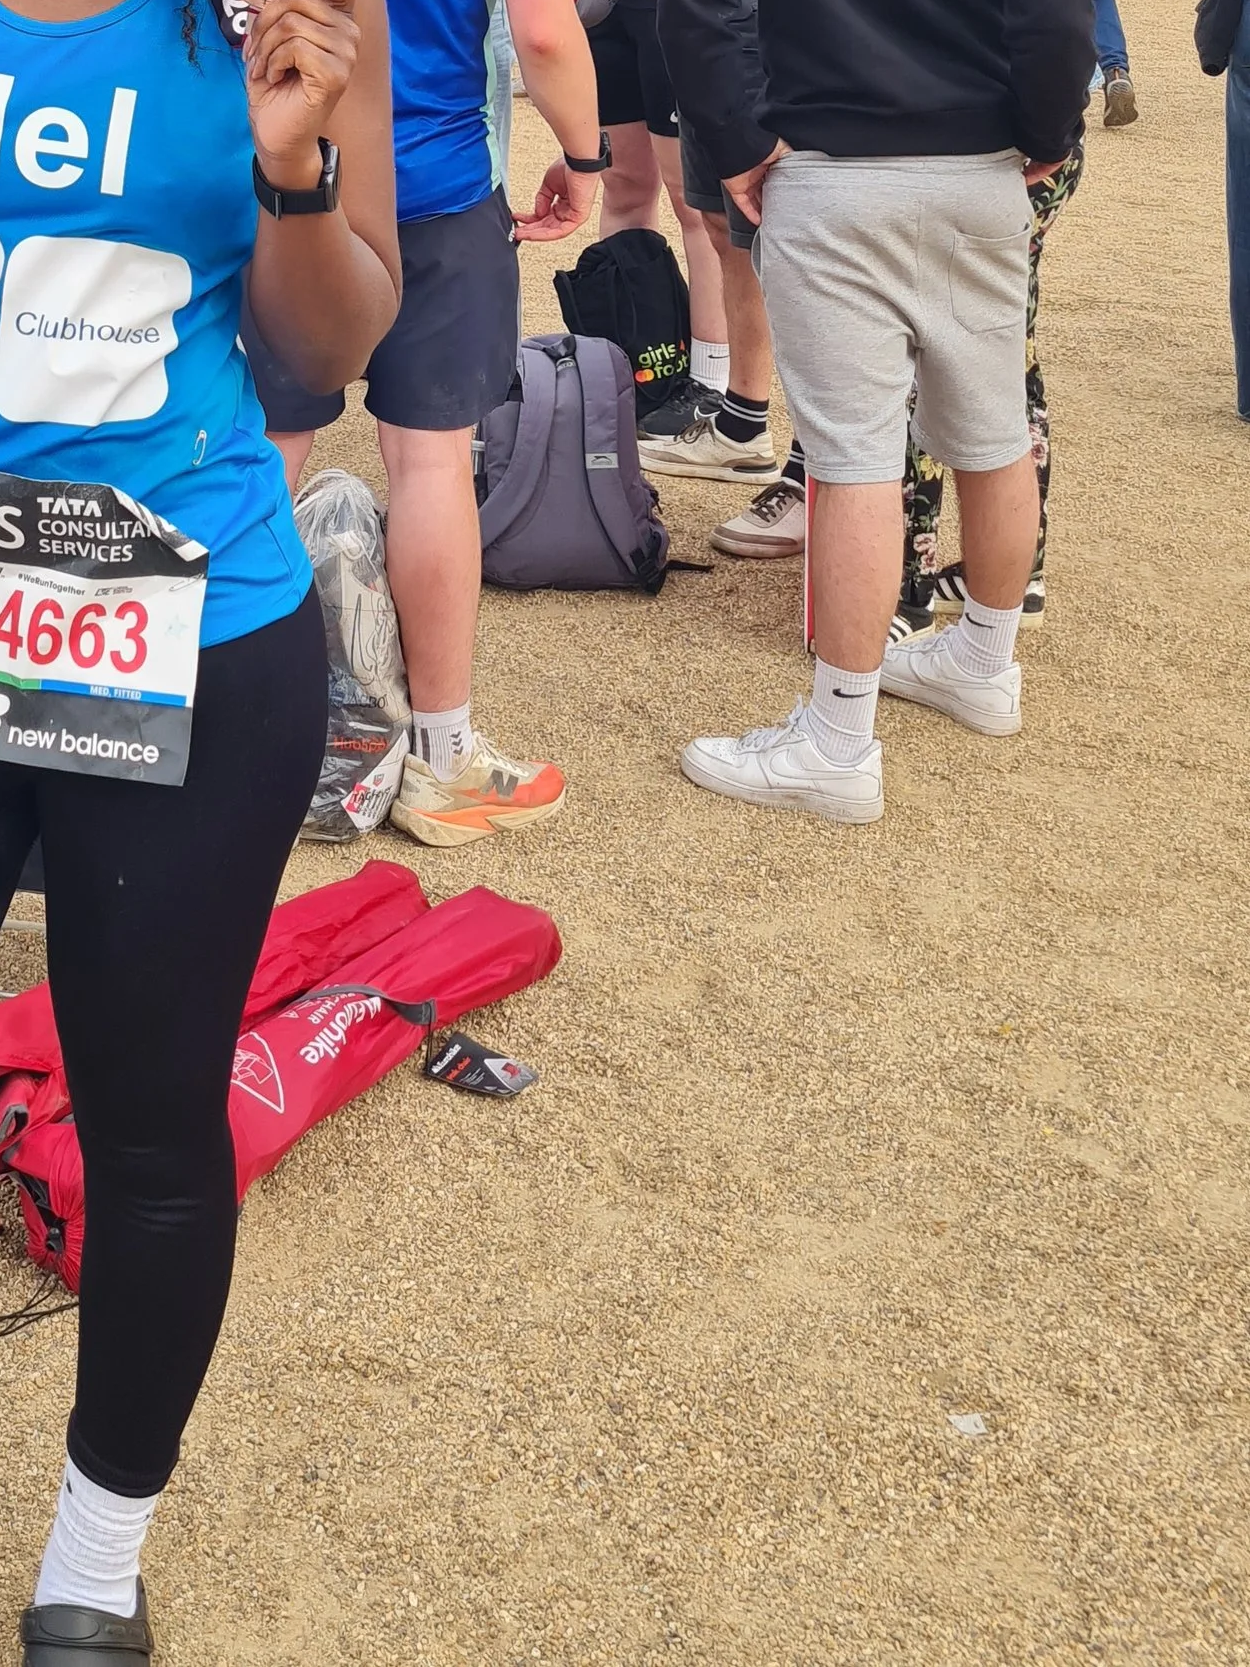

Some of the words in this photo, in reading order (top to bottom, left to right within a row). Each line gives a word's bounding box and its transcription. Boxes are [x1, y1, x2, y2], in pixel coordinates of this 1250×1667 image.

[15, 311, 161, 344] Clubhouse
[639, 343, 676, 369] girls
[37, 497, 102, 517] TATA
[39, 539, 133, 563] SERVICES
[18, 572, 86, 596] #WeRunTogether
[114, 688, 142, 701] FITTED
[8, 725, 56, 750] new
[60, 728, 159, 764] balance
